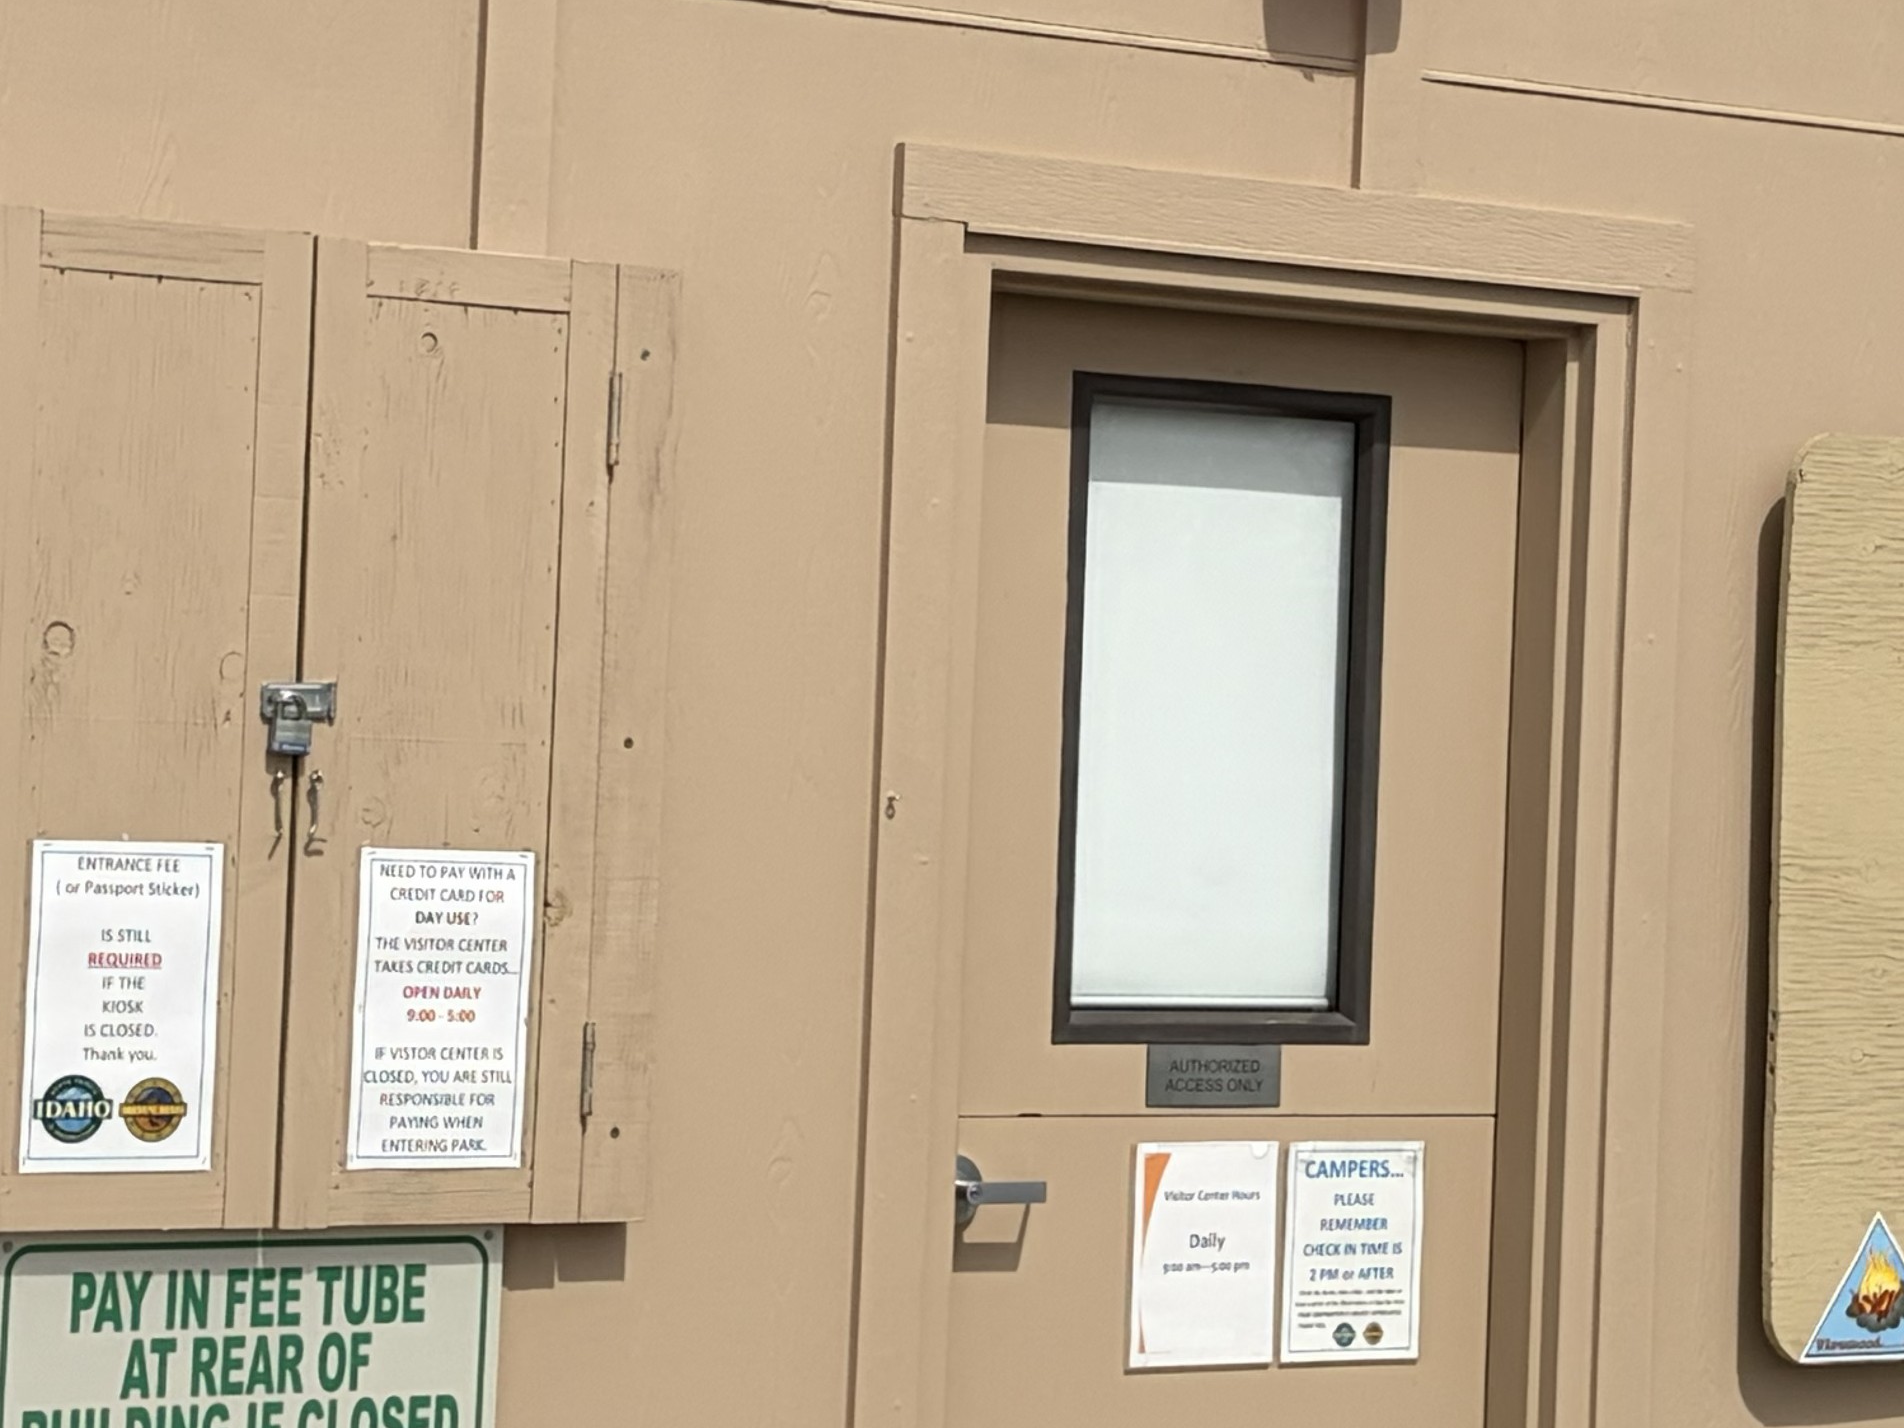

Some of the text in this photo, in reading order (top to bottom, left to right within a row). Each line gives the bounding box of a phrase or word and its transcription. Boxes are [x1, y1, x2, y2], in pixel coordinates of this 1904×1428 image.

[77, 856, 180, 873] ENTRANCE FEE
[380, 864, 516, 881] NEED TO PAY WITH A
[66, 883, 80, 893] or
[85, 881, 144, 896] Passport
[149, 882, 200, 898] Sticker)
[390, 887, 504, 903] CREDIT CARD FOR
[415, 911, 478, 925] DAY USE?
[101, 929, 151, 943] IS STILL
[376, 937, 507, 952] THE VISITOR CENTER
[88, 953, 162, 968] REQUIRED
[375, 960, 413, 973] TAKES
[417, 960, 463, 974] CREDIT
[102, 976, 145, 990] IF THE
[403, 985, 481, 999] OPEN DAILY
[102, 1000, 144, 1013] KIOSK
[84, 1023, 158, 1037] IS CLOSED.
[83, 1047, 157, 1063] Thank you.
[375, 1047, 503, 1060] IF VISTOR CENTER IS
[1169, 1059, 1261, 1073] AUTHORIZED
[363, 1070, 512, 1085] CLOSED, YOU ARE STILL
[1165, 1078, 1264, 1092] ACCESS ONLY
[379, 1093, 495, 1106] RESPONSIBLE FOR
[36, 1100, 110, 1118] IDAHO
[389, 1116, 483, 1129] PAYING WHEN
[381, 1139, 448, 1152] ENTERING
[1164, 1190, 1260, 1201] Visitor Center Hours
[1334, 1193, 1375, 1206] PLEASE
[1320, 1217, 1388, 1231] REMEMBER
[1189, 1233, 1226, 1252] Daily
[1303, 1242, 1403, 1256] CHECK IN TIME IS
[1309, 1267, 1394, 1281] 2 PM or AFTER
[70, 1263, 426, 1334] PAY IN FEE TUBE
[119, 1331, 372, 1400] AT REAR OF
